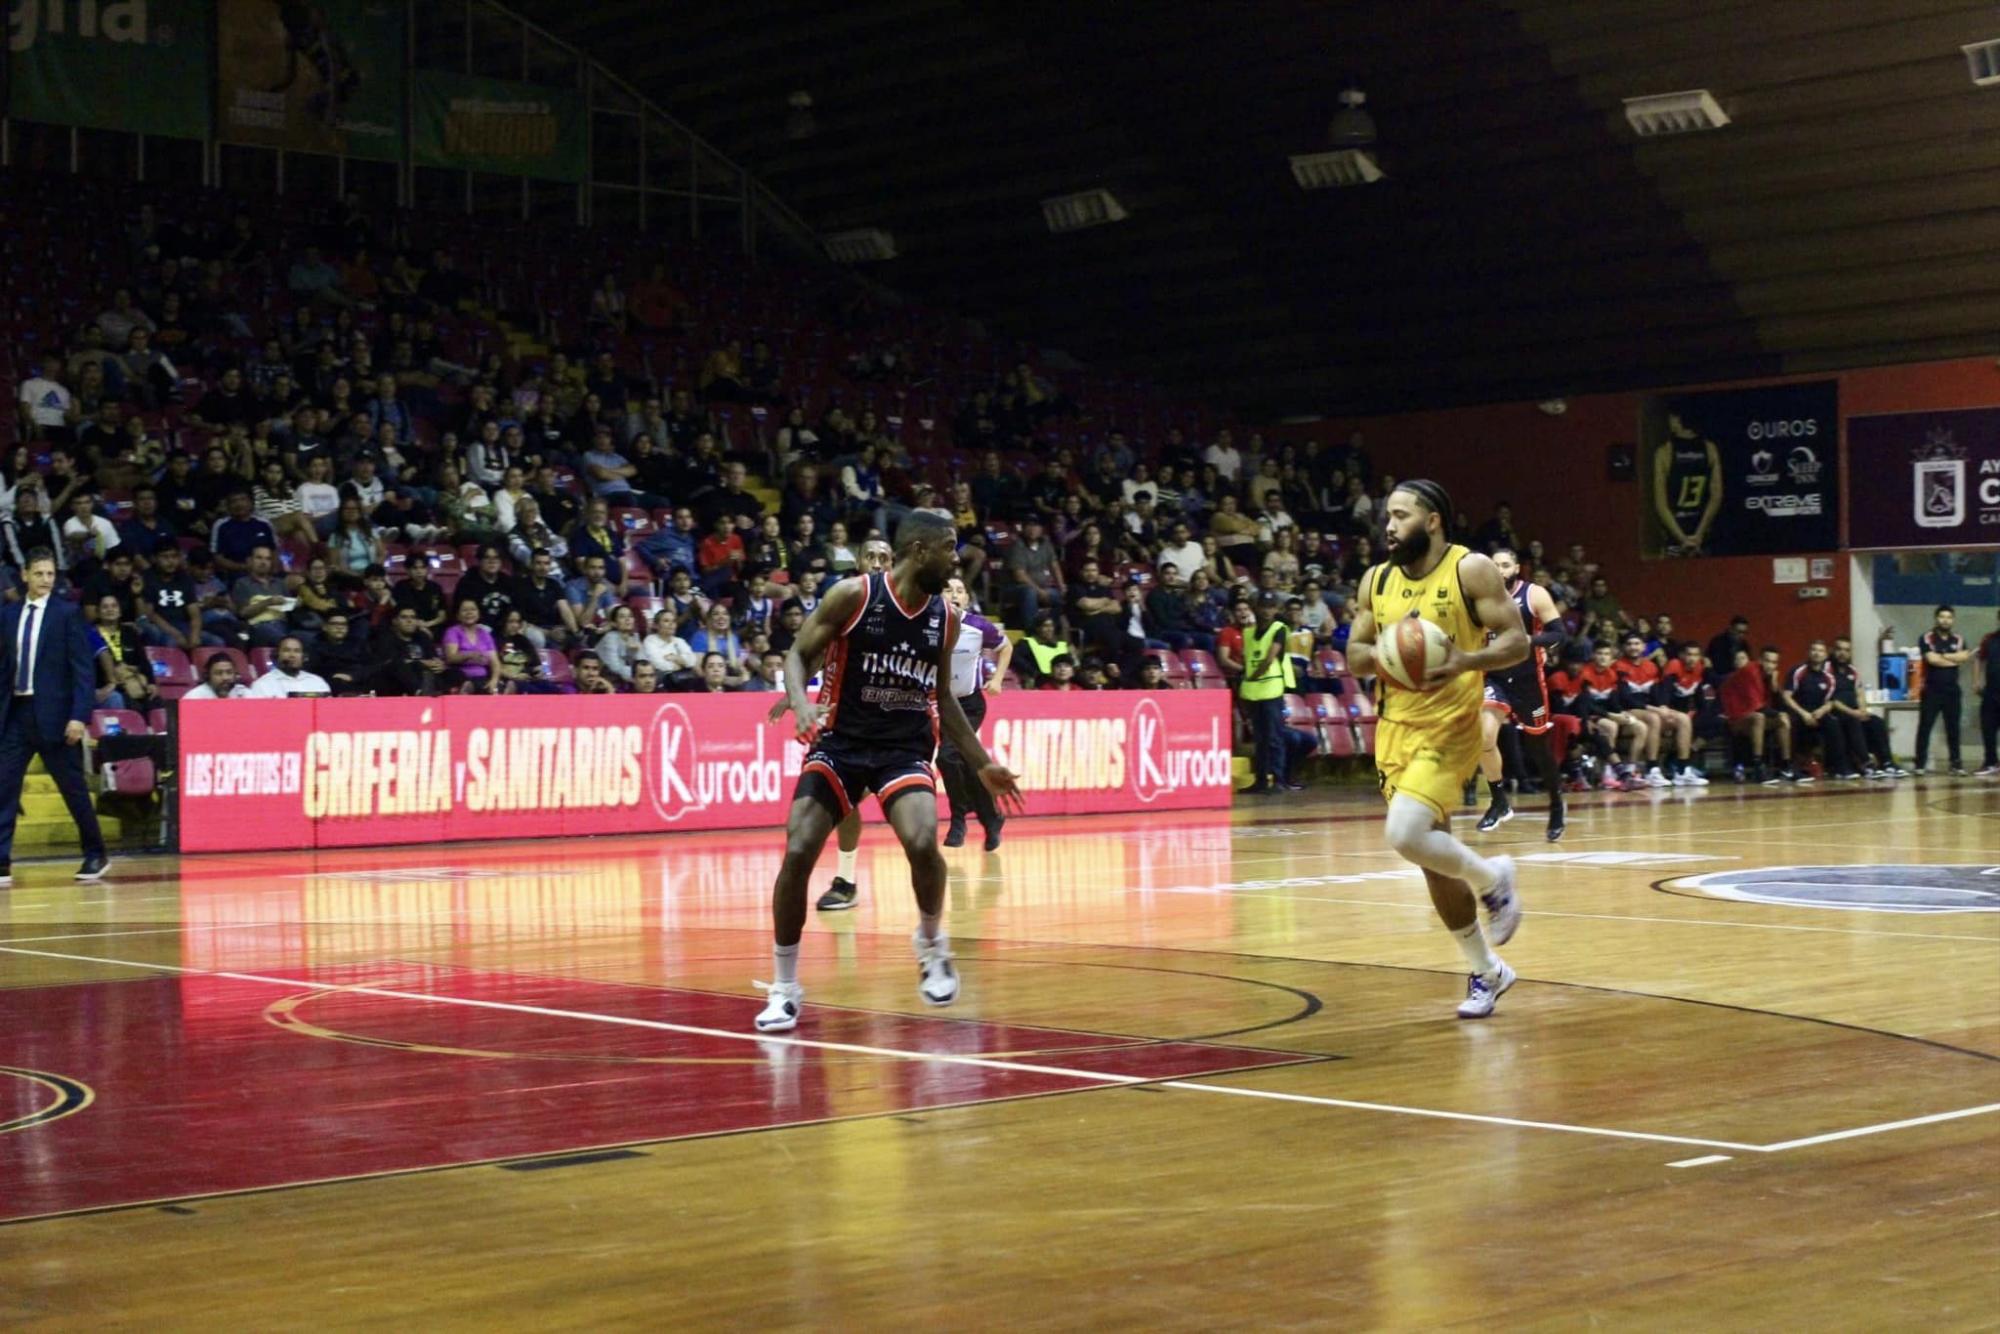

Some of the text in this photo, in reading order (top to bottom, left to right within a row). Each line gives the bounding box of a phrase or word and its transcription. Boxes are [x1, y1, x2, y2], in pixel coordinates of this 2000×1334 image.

[862, 652, 939, 689] TIJUANA
[185, 753, 212, 797] LOS
[214, 752, 281, 796] EXPERTOS
[282, 752, 302, 794] EN
[303, 708, 452, 819] GRIFERÍA
[466, 725, 643, 812] SANITARIOS
[660, 720, 781, 804] Kuroda
[993, 713, 1231, 790] SANITARIOS Kuroda
